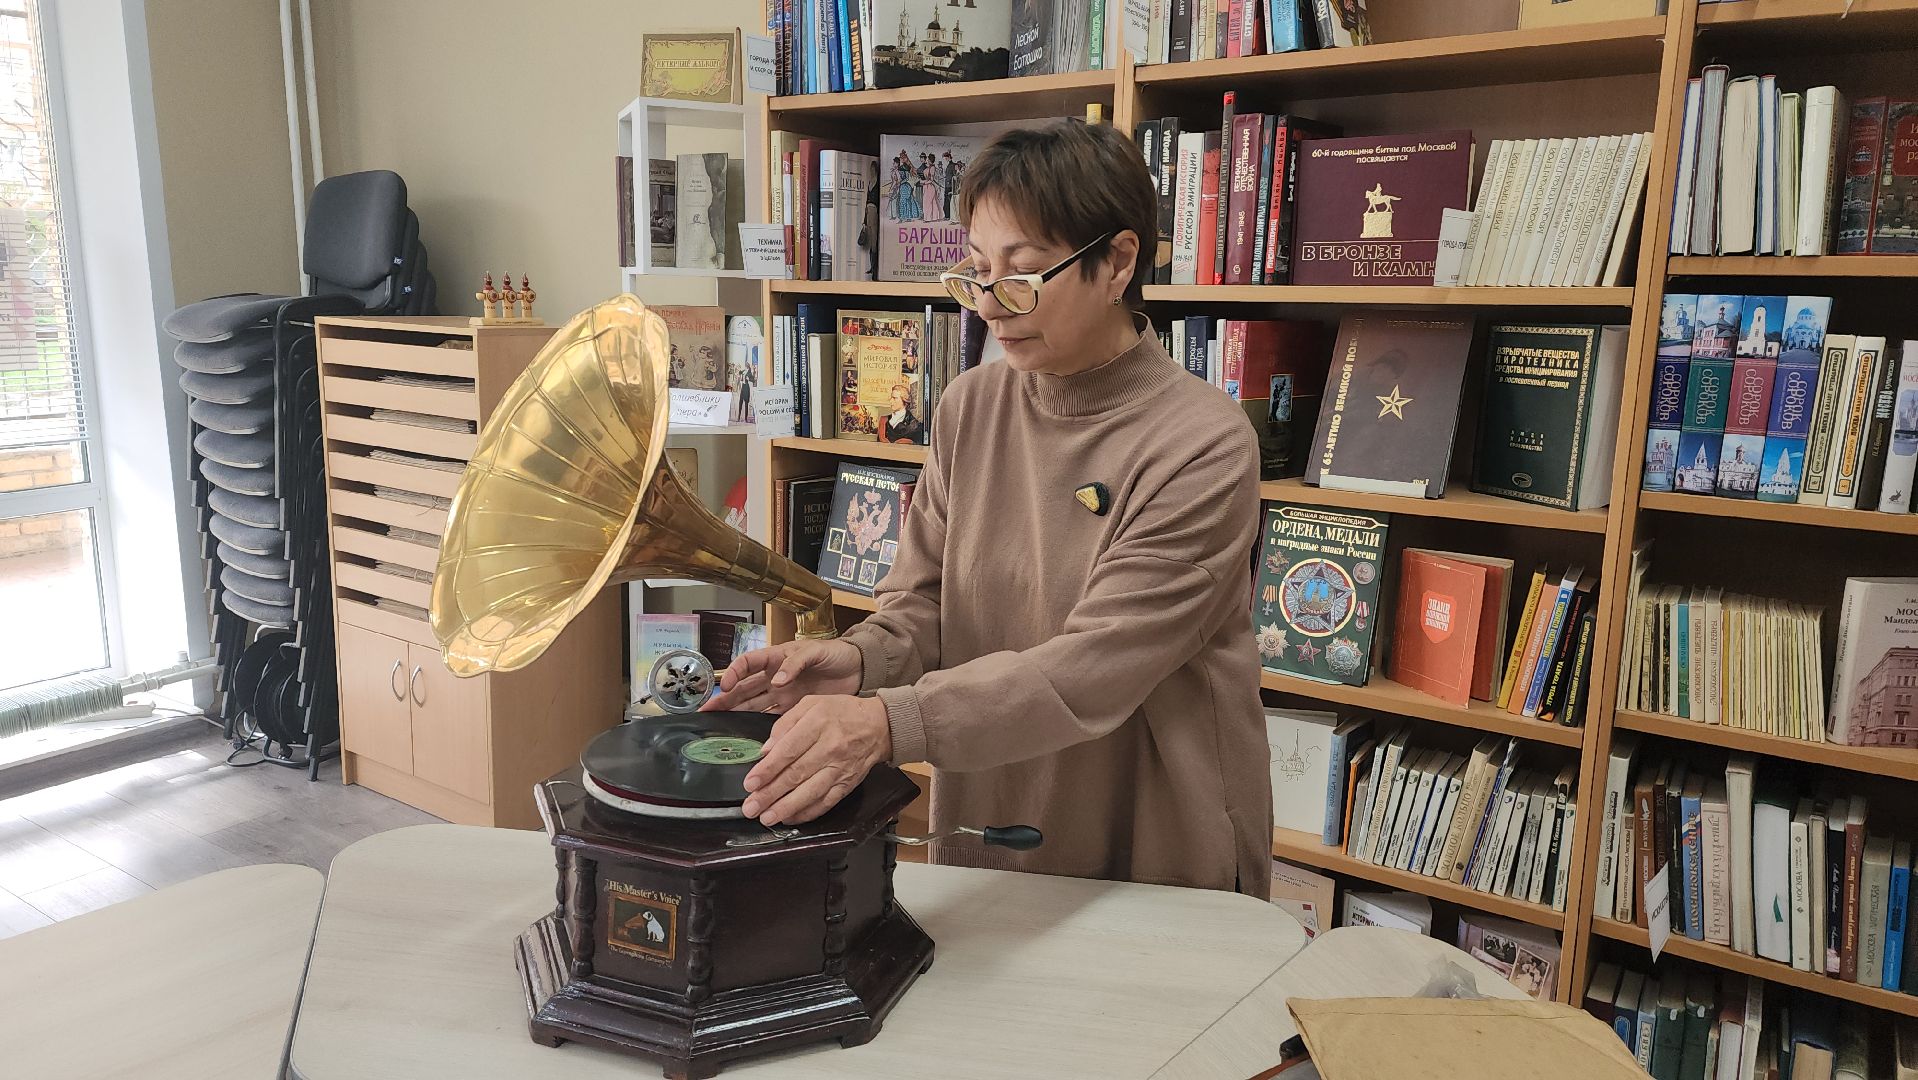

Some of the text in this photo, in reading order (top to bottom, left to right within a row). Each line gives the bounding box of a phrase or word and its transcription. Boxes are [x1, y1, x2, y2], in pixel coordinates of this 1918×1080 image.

[1015, 22, 1039, 49] Лесной
[750, 55, 769, 64] ГОРОДА
[1241, 128, 1250, 192] ОТЕЧЕСТВЕННАЯ
[1331, 148, 1374, 158] годовщине
[1375, 145, 1399, 155] битвы
[1401, 146, 1417, 154] под
[1417, 141, 1457, 152] Москвой
[1356, 154, 1408, 164] посвящается
[1161, 130, 1171, 195] ПОДВИГ НАРОДА
[1248, 163, 1256, 192] ВОЙНА
[1175, 148, 1189, 247] ПОЛИТИЧЕСКАЯ ИСТОРИЯ
[1185, 152, 1198, 250] РУССКОЙ ЭМИГРАЦИИ
[757, 238, 783, 247] ТЕХНИКА
[905, 246, 914, 263] И
[1302, 244, 1402, 261] В БРОНЗЕ
[1353, 261, 1369, 277] И
[863, 355, 898, 363] МИРОВАЯ
[1495, 356, 1579, 369] ПИРОТЕХНИКА
[1497, 346, 1580, 360] ВЗРЫВЧАТЫЕ ВЕЩЕСТВА
[863, 363, 897, 371] ИСТОРИЯ
[1495, 364, 1578, 378] СРЕДСТВА ИНИЦИИРОВАНИЯ
[1504, 376, 1547, 387] послевоенный
[1547, 381, 1570, 389] период
[1659, 365, 1675, 421] СОРОКОВ
[1667, 373, 1682, 413] СОРОК
[671, 390, 721, 404] олшебники
[1696, 368, 1713, 425] СОРОКОВ
[1706, 376, 1720, 417] СОРОК
[1739, 368, 1756, 426] СОРОКОВ
[1749, 376, 1764, 418] СОРОК
[1781, 371, 1800, 430] СОРОКОВ
[1792, 380, 1807, 422] СОРОК
[1875, 391, 1890, 419] МОСКВА
[1323, 413, 1342, 467] 65-ЛЕТИЮ
[1335, 363, 1353, 413] ВЕЛИКОЙ
[1820, 412, 1830, 434] МОСКВА
[1851, 414, 1860, 436] МОСКВА
[841, 472, 874, 488] РУССКАЯ
[1289, 511, 1367, 527] БОЛЬШАЯ ЭНЦИКЛОПЕДИЯ
[1272, 519, 1380, 548] ОРДЕНА, МЕДАЛИ
[1277, 538, 1319, 552] наградные
[1320, 543, 1345, 556] знаки
[1347, 545, 1377, 561] России
[1427, 598, 1451, 613] ЗНАКИ
[1546, 661, 1564, 706] УГРОЗА ТЕРАКТА
[1442, 792, 1472, 873] ЗОЛОТОЕ КОЛЬЦО
[1848, 856, 1856, 883] Москвы
[622, 883, 658, 901] Master's
[1867, 930, 1875, 965] МОСКВА
